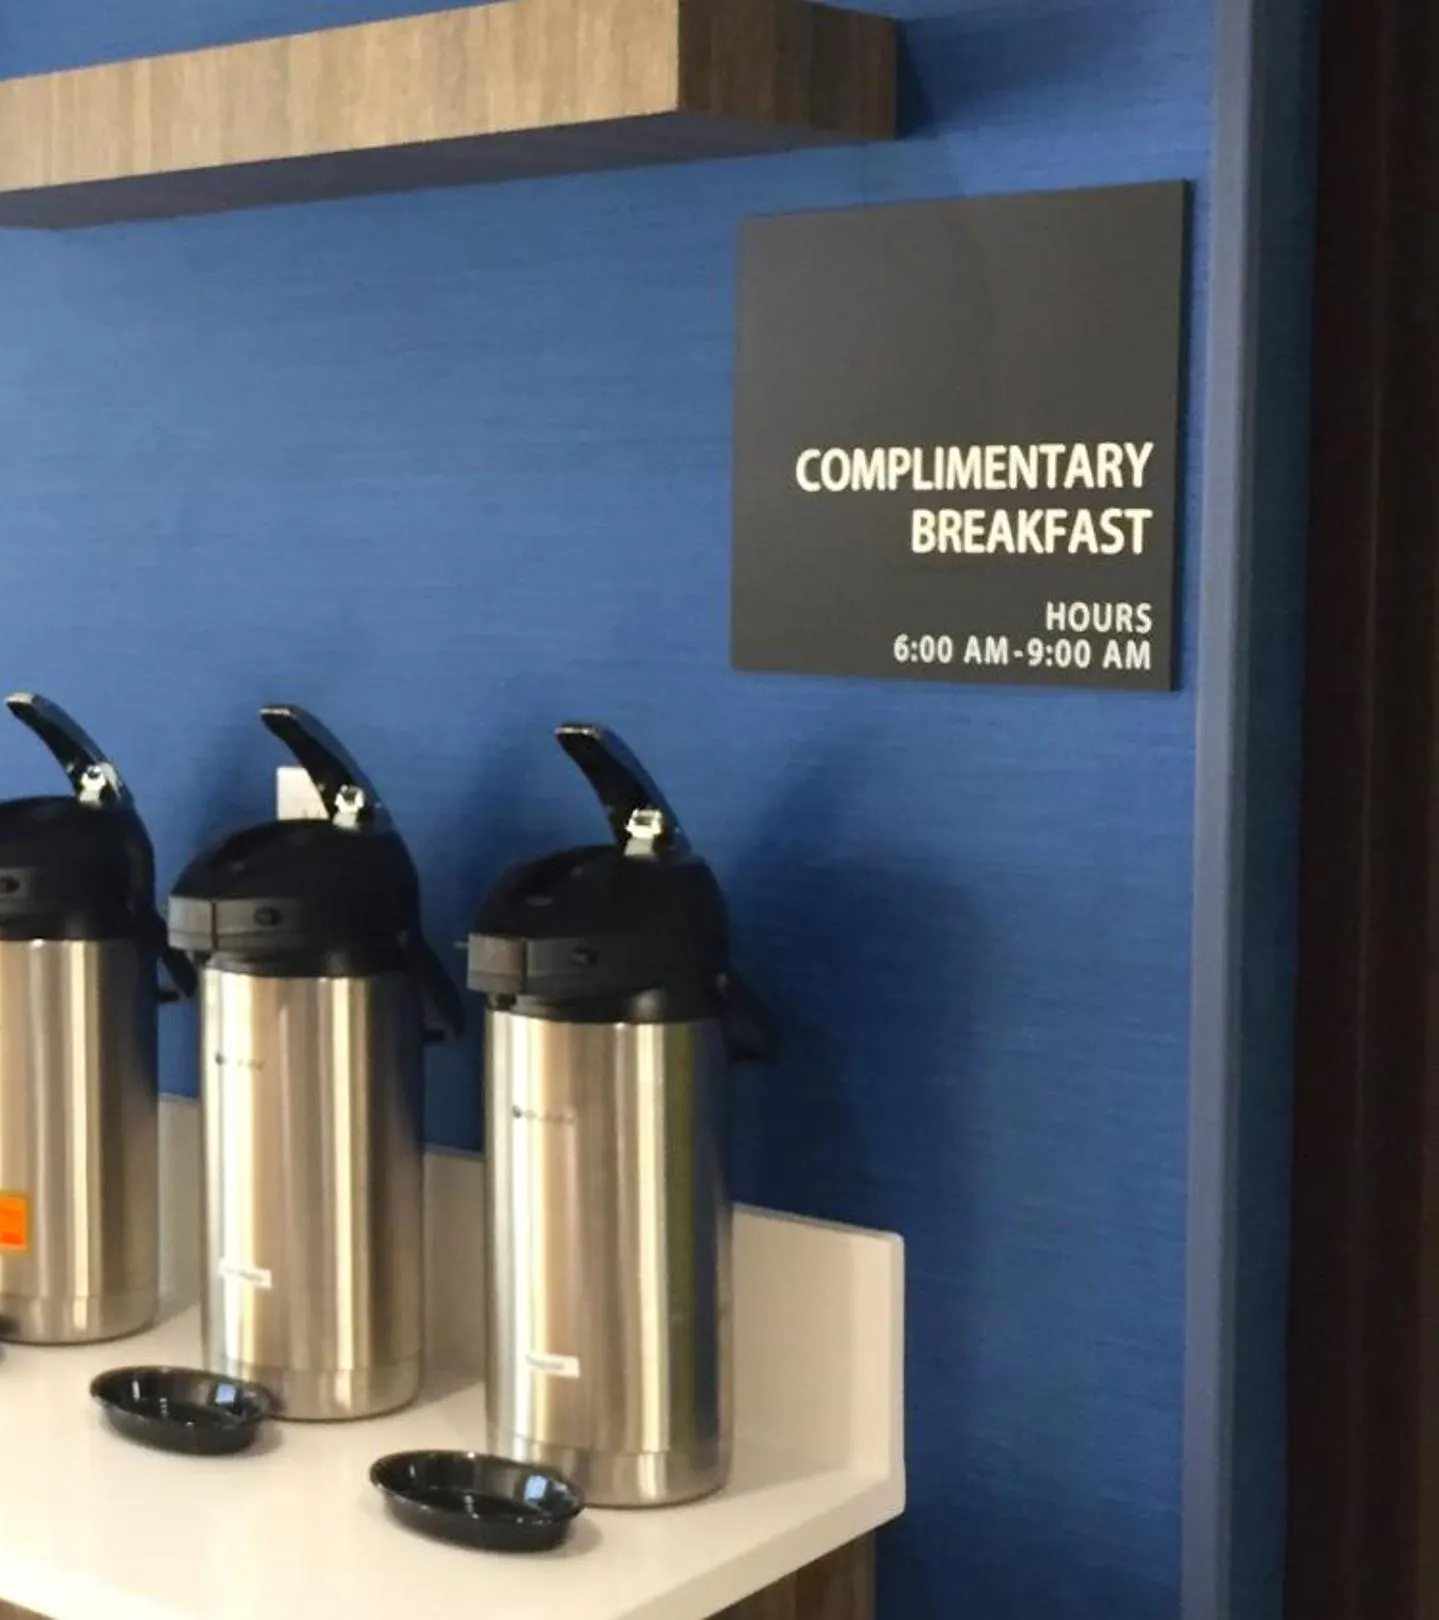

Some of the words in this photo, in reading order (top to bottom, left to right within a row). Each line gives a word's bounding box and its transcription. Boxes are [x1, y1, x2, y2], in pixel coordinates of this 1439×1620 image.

[795, 441, 1154, 493] COMPLIMENTARY
[911, 507, 1154, 555] BREAKFAST
[1045, 601, 1153, 634] HOURS
[893, 633, 954, 664] 6:00
[1102, 639, 1151, 670] AM
